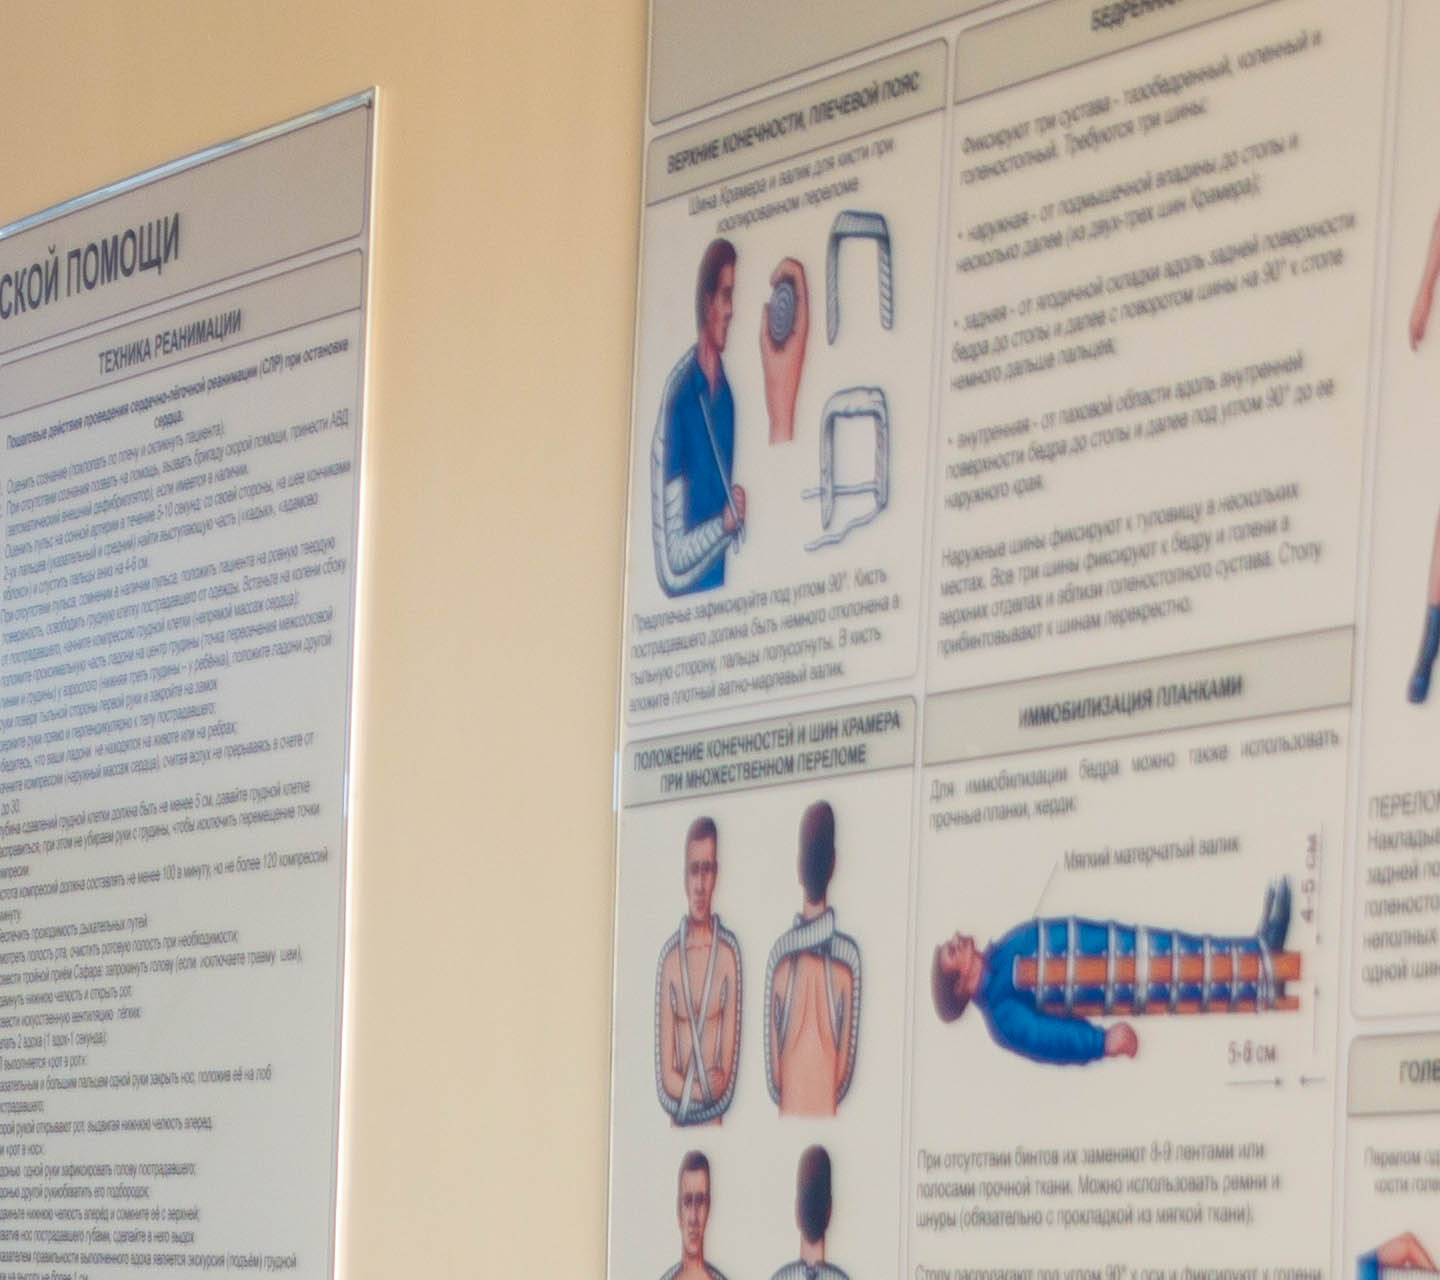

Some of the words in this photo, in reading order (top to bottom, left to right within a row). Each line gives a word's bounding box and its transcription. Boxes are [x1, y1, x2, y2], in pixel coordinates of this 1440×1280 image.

[66, 210, 180, 300] ПОМОЩИ
[99, 336, 151, 375] ТЕХНИКА
[154, 308, 242, 361] РЕАНИМАЦИИ
